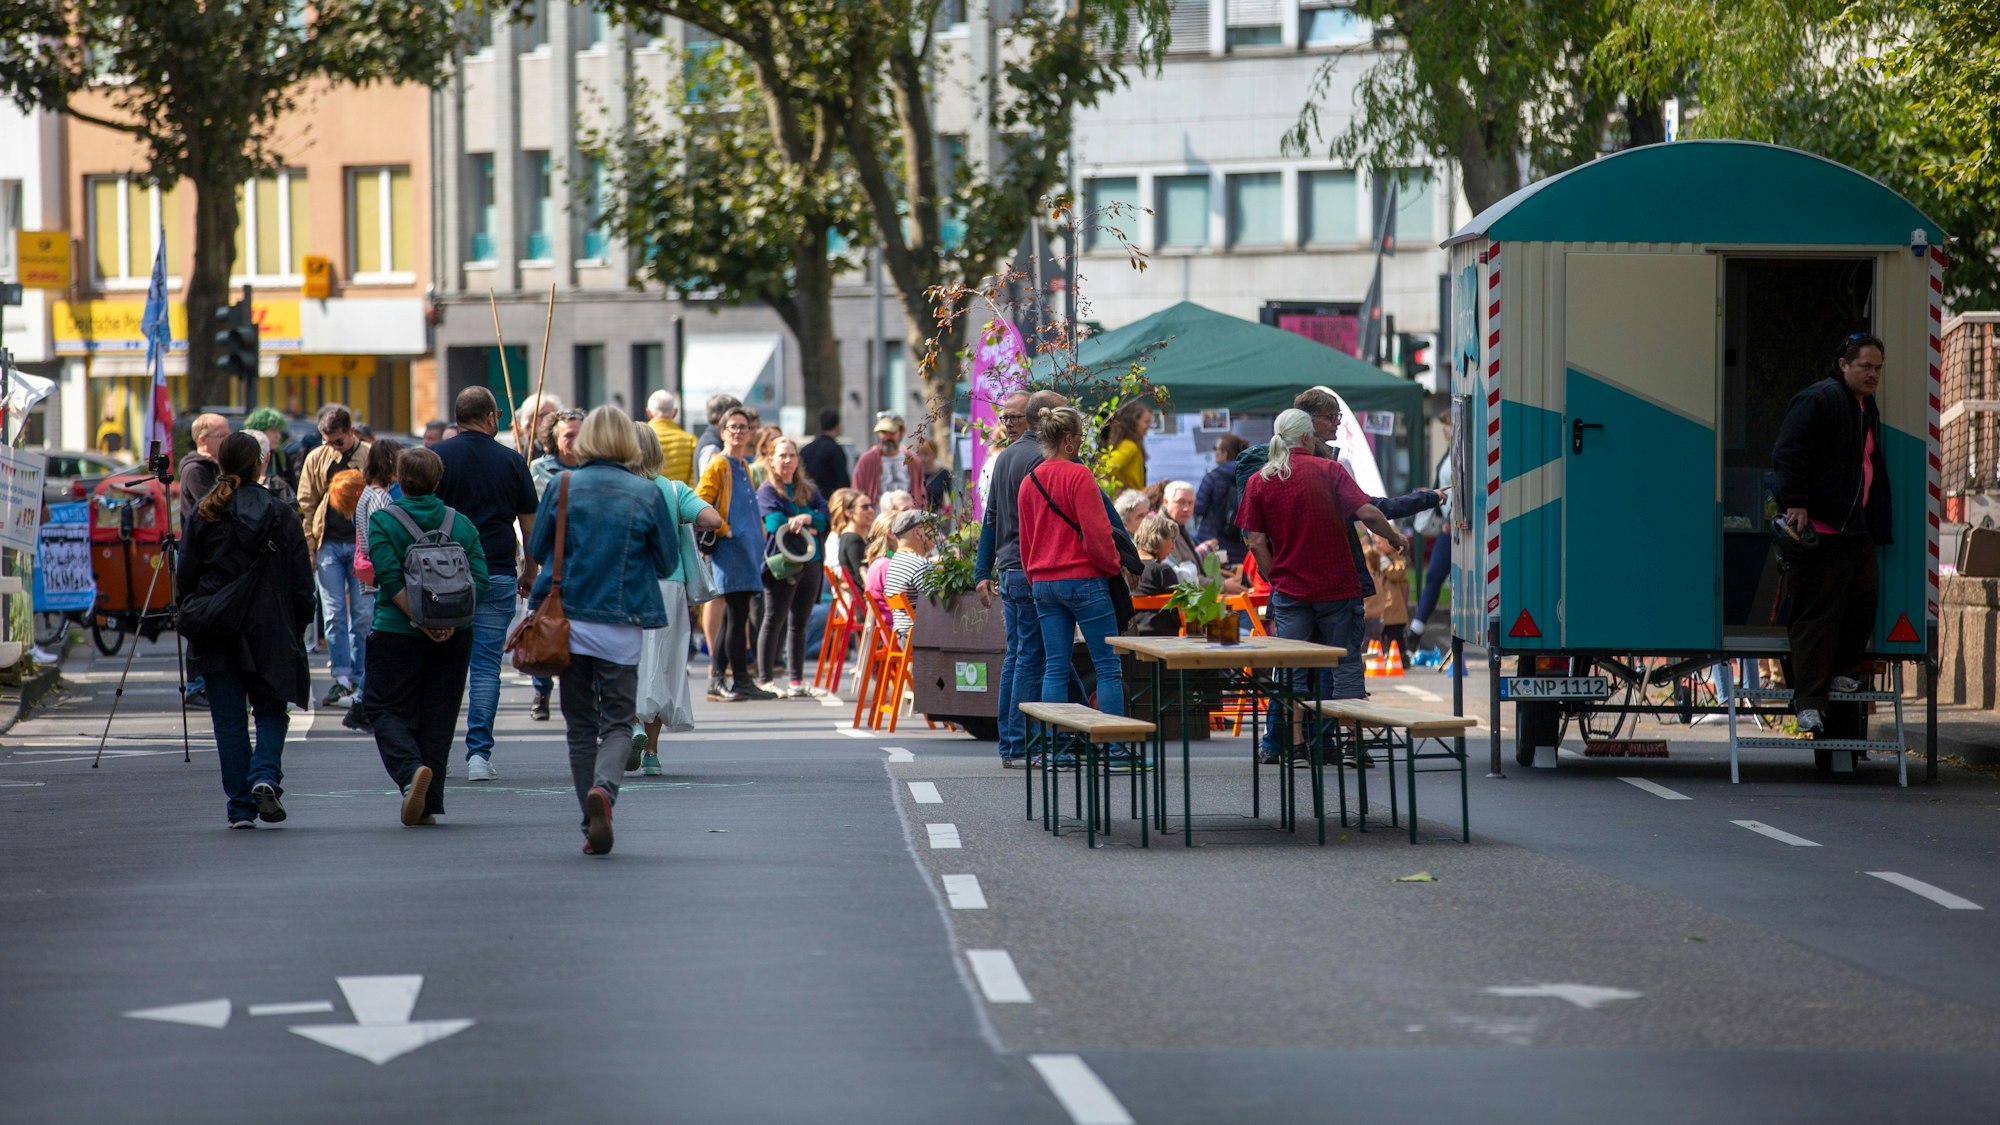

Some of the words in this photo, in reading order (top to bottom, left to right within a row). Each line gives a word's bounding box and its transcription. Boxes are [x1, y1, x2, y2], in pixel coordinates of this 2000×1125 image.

[1510, 680, 1521, 695] K
[1533, 680, 1556, 695] NP
[1560, 680, 1605, 695] 1112
